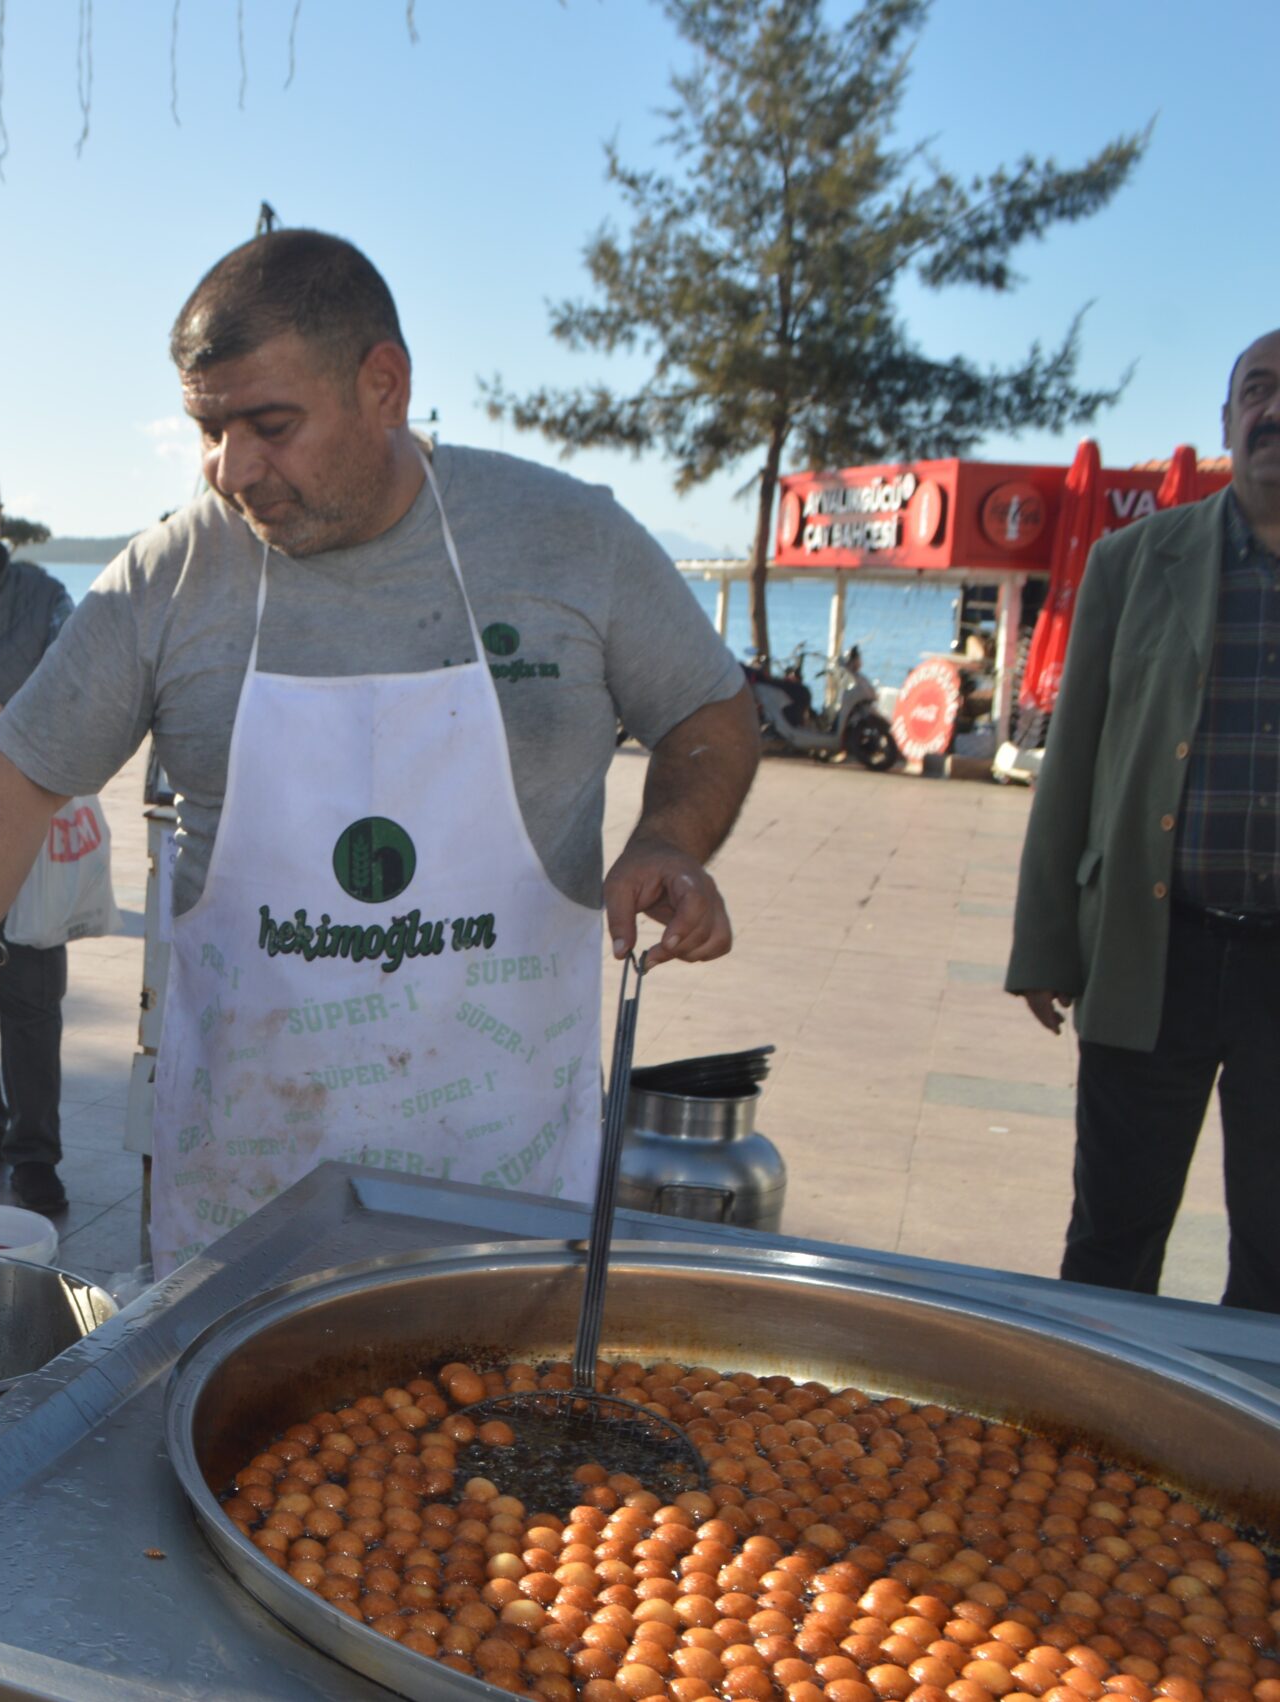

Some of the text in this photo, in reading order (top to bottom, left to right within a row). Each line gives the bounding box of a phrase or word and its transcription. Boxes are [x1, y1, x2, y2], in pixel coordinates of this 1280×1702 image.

[259, 904, 497, 973] hekimoğlu un
[465, 953, 559, 987] SÜPER-1
[287, 983, 418, 1035] SÜPER-1
[455, 1001, 537, 1064] SÜPER-1
[401, 1071, 495, 1119] SÜPER-1
